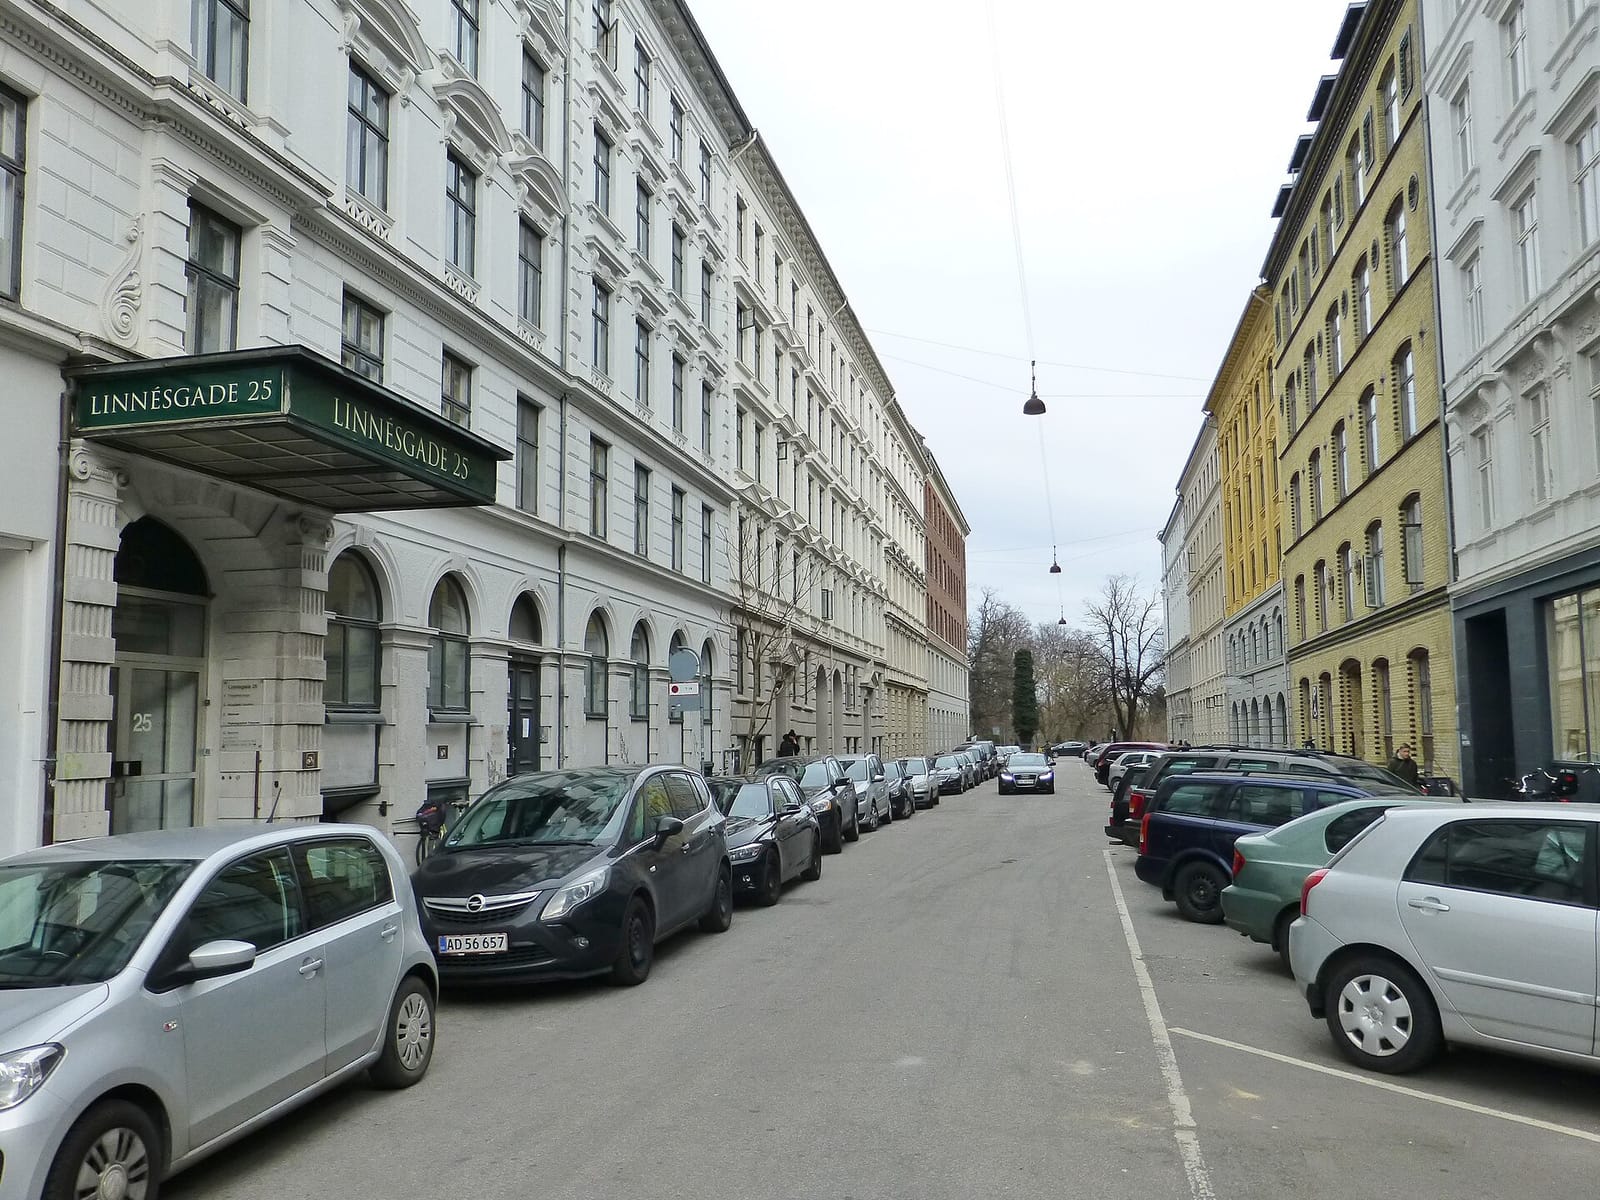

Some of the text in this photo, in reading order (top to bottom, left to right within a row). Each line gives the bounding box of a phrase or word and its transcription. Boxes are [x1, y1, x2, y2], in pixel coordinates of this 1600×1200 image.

[90, 380, 273, 415] LINNÉSGADE 25
[333, 397, 469, 480] LINNÉSGADE 25
[133, 713, 152, 731] 25
[447, 936, 504, 950] AD 56 657
